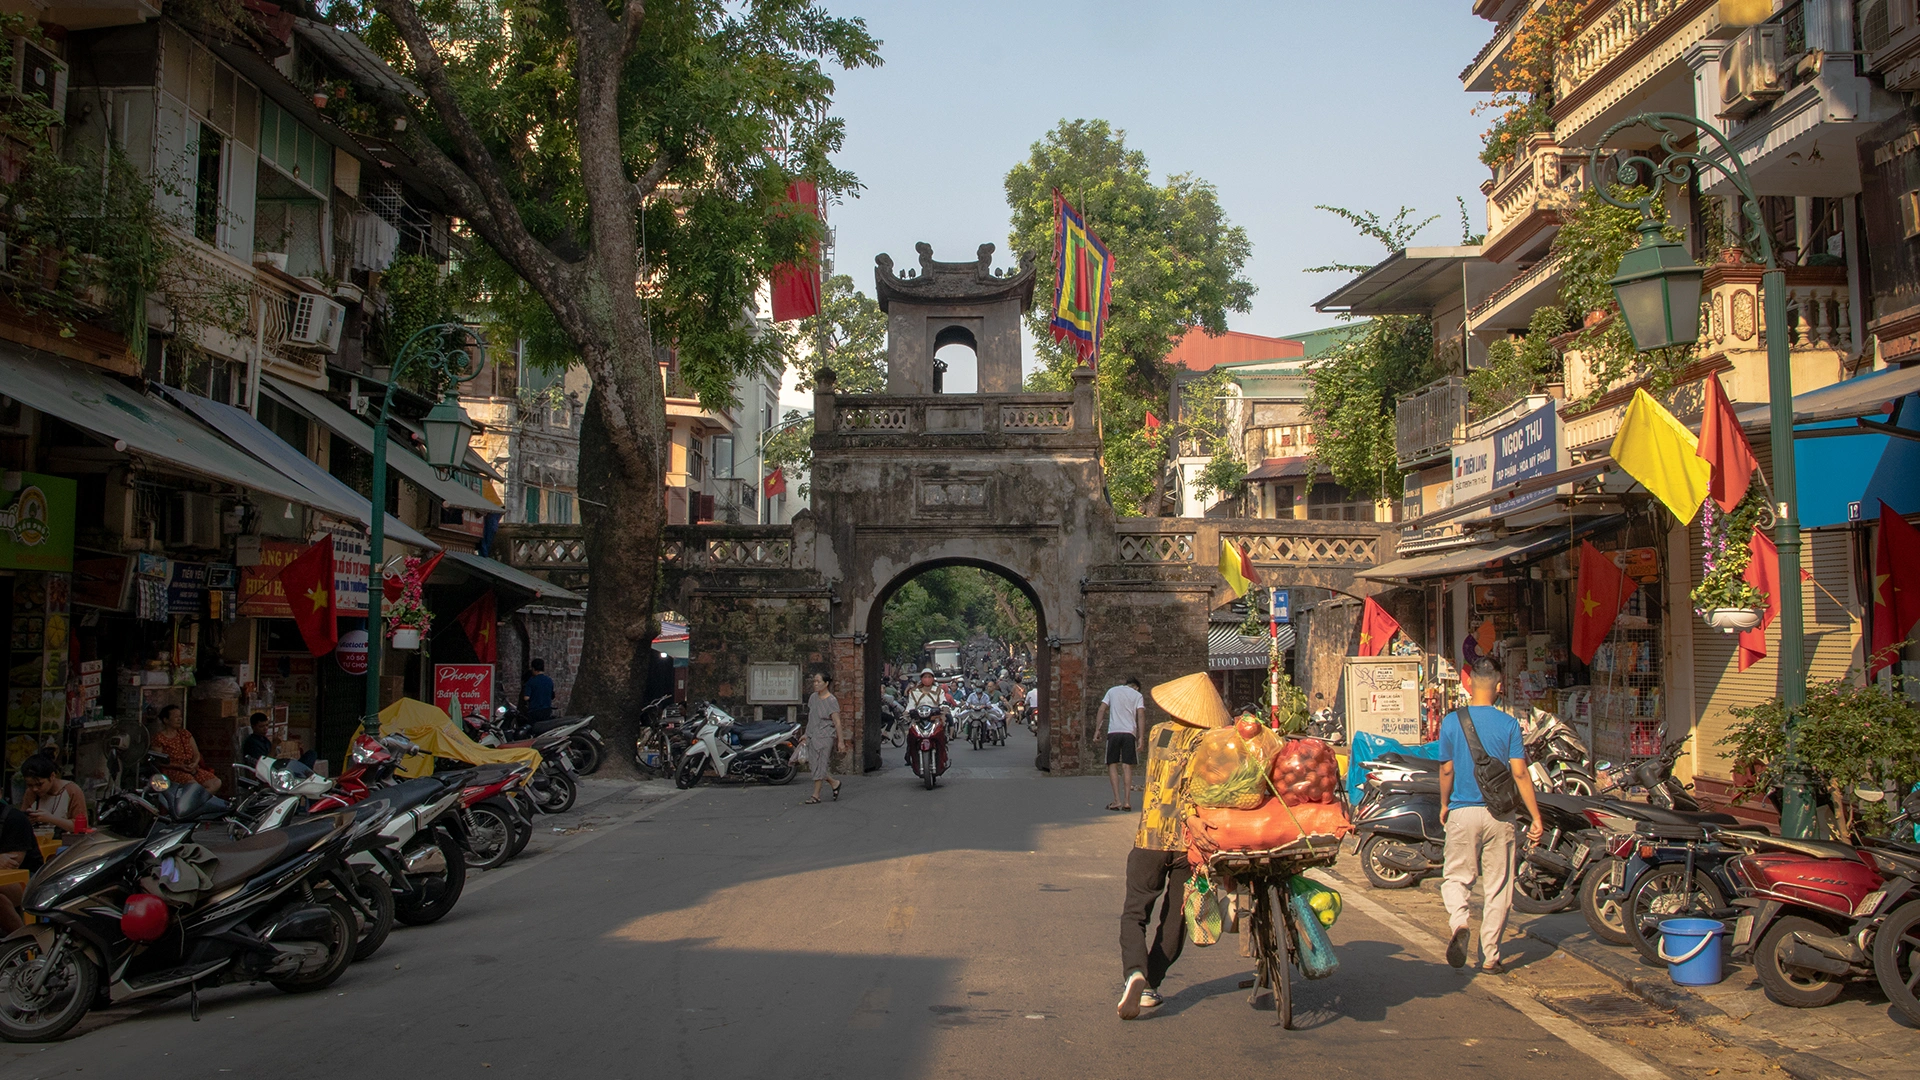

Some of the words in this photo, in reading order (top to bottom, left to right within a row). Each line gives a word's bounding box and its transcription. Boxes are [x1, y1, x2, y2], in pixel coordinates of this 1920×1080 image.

[1502, 428, 1524, 458] NGỌC
[1525, 417, 1542, 446] THU
[1463, 454, 1475, 476] THIÊN
[1476, 453, 1487, 472] LONG
[1849, 504, 1859, 519] 12
[1217, 657, 1239, 667] FOOD
[1797, 875, 1848, 886] LEAD
